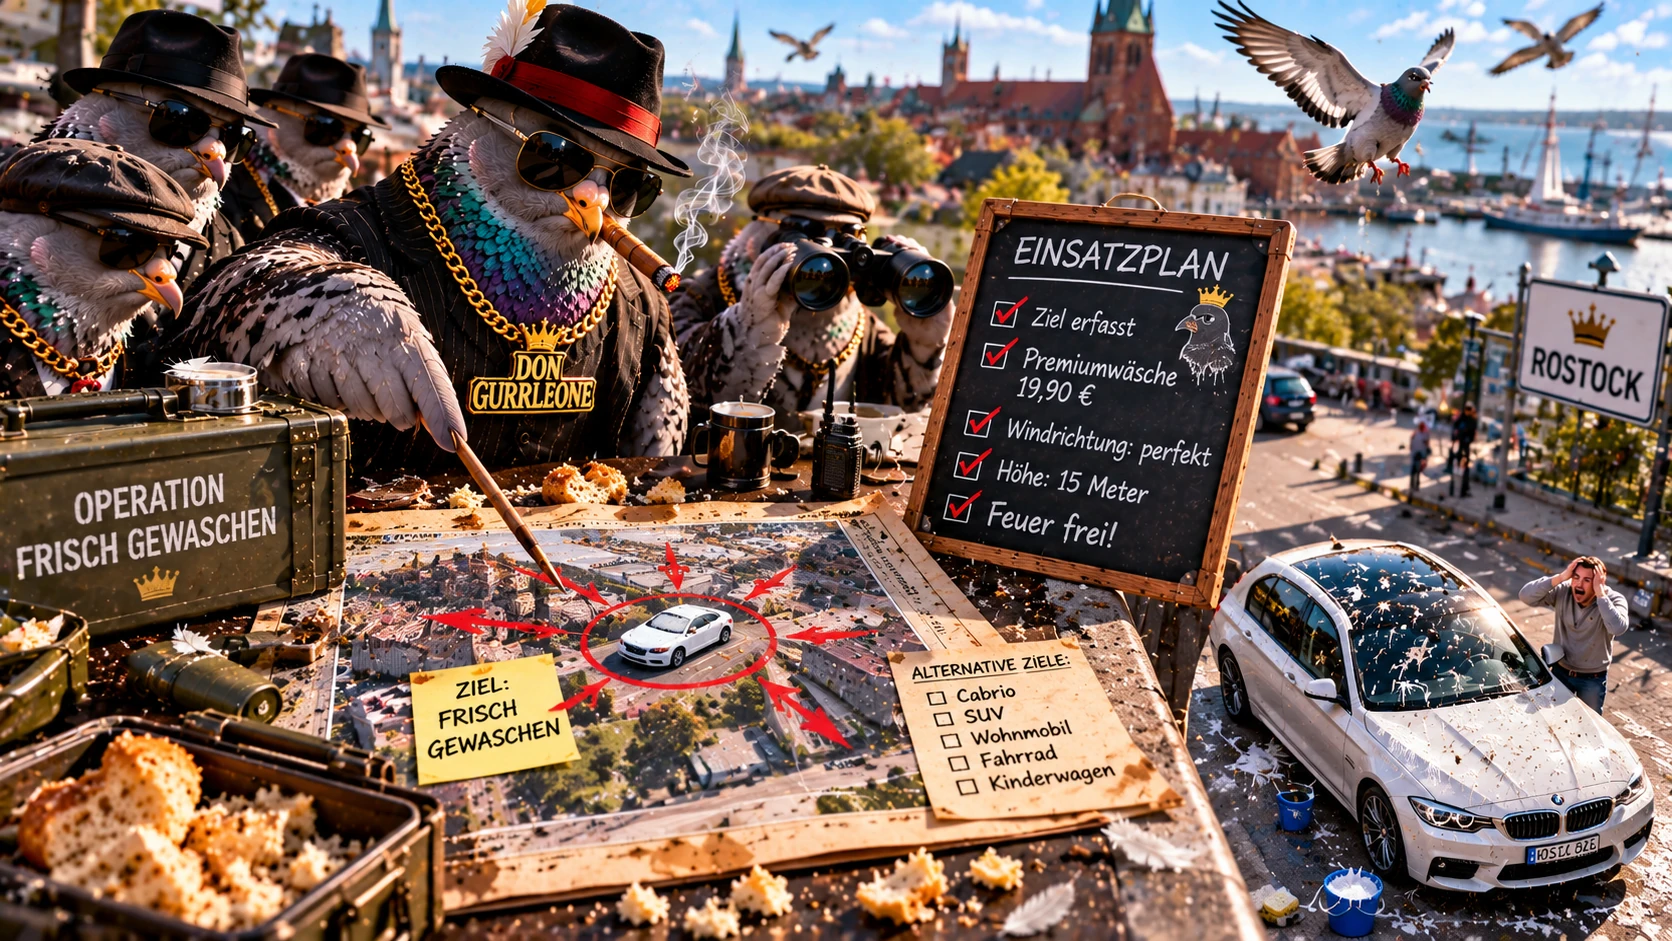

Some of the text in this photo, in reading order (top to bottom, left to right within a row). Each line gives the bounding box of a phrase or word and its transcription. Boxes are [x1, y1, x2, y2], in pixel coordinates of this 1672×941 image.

[1014, 236, 1229, 281] EINSATZPLAN
[1031, 307, 1137, 336] Ziel erfasst
[515, 354, 563, 381] DON
[1022, 347, 1178, 387] Premiumwäsche
[1531, 346, 1644, 403] ROSTOCK
[472, 380, 594, 410] GURRLEONE
[1016, 376, 1096, 407] 19,90 €
[1007, 418, 1213, 468] Windrichtung: perfekt
[996, 459, 1149, 504] Höhe: 15 Meter
[74, 473, 225, 525] OPERATION
[987, 501, 1119, 549] Feuer frei!
[16, 506, 277, 581] FRISCH GEWASCHEN
[911, 658, 1018, 680] ALTERNATIVE
[456, 677, 510, 699] ZIEL:
[956, 684, 1016, 703] Cabrio
[438, 699, 518, 730] FRISCH
[964, 706, 1004, 724] SUV
[427, 718, 561, 760] GEWASCHEN
[970, 719, 1073, 745] Wohnmobil
[979, 743, 1058, 769] Fahrrad
[989, 765, 1116, 792] Kinderwagen
